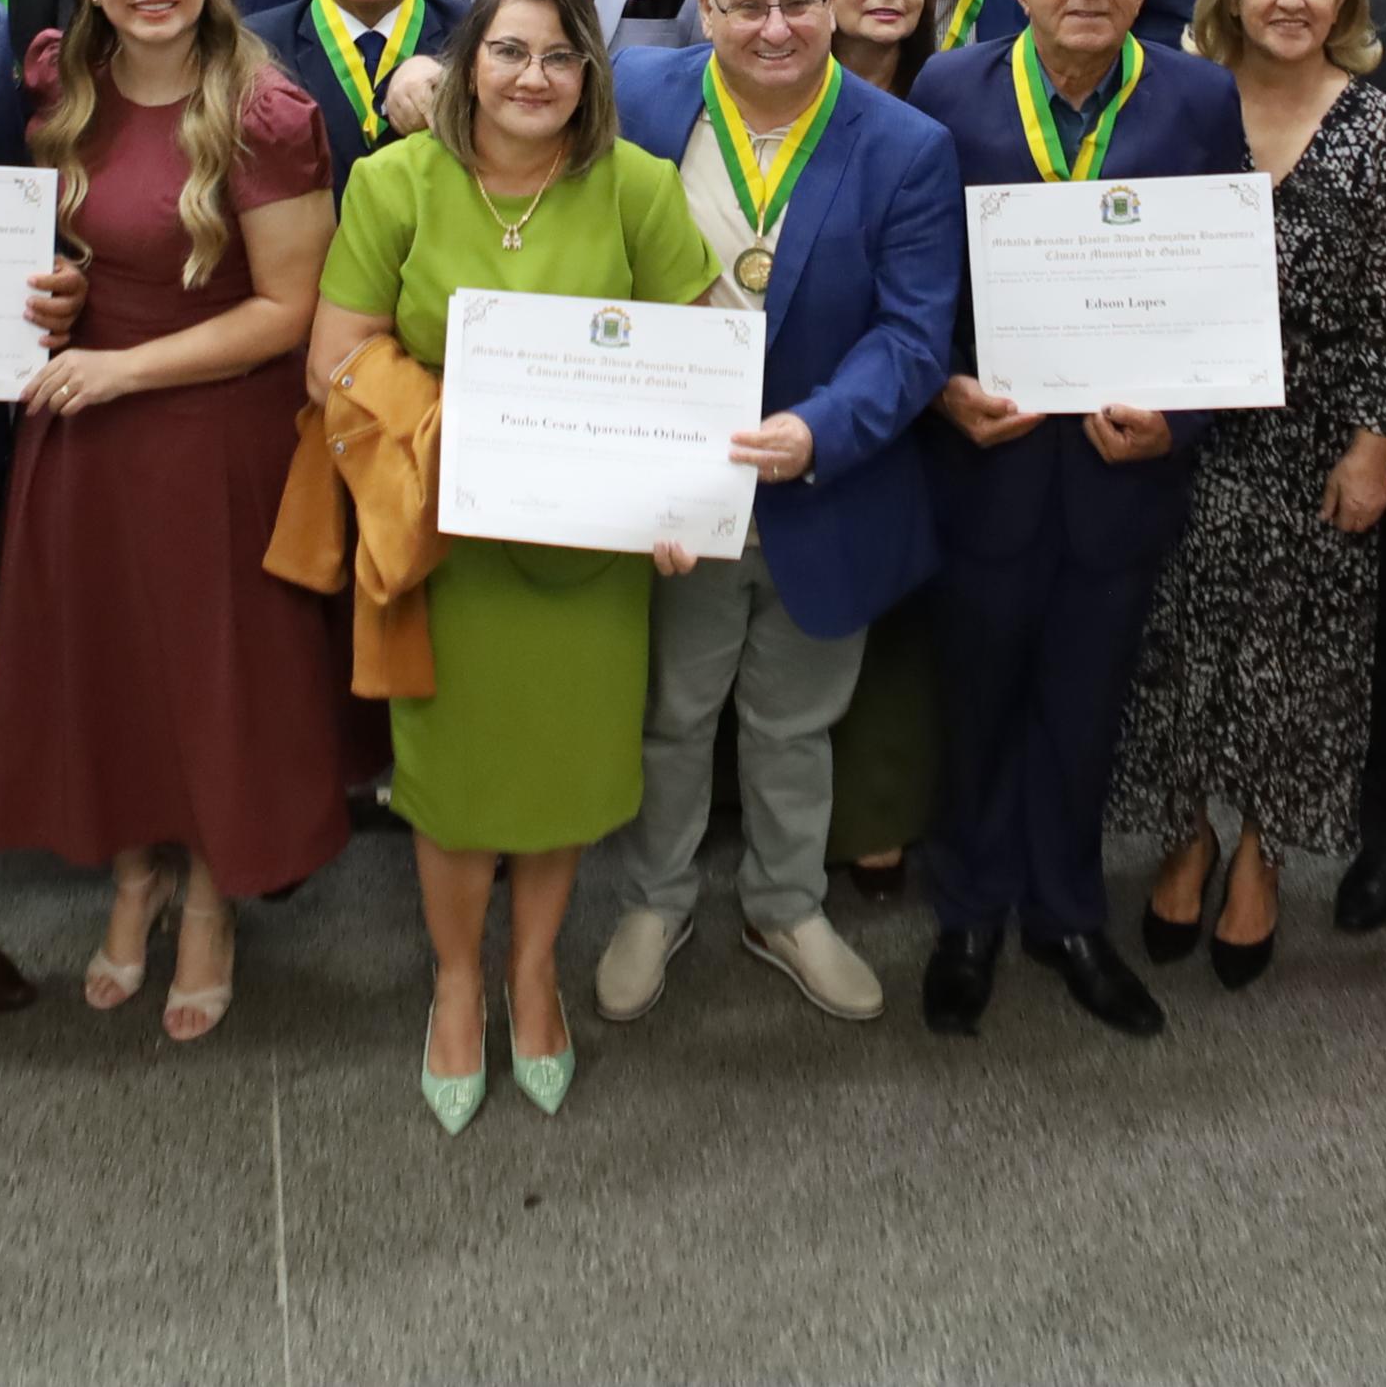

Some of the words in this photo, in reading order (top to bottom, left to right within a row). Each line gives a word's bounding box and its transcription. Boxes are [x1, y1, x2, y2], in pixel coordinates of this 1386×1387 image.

[1044, 247, 1086, 261] Câmara
[1090, 245, 1142, 261] Municipal
[1145, 246, 1156, 258] de
[1085, 297, 1124, 310] Edson
[1129, 297, 1166, 311] Lopes
[526, 365, 569, 379] Câmara
[573, 368, 628, 386] Municipal
[630, 373, 641, 385] de
[501, 413, 538, 427] Paulo
[542, 417, 578, 431] Cesar
[584, 421, 649, 438] Aparecido
[654, 428, 708, 443] Orlando
